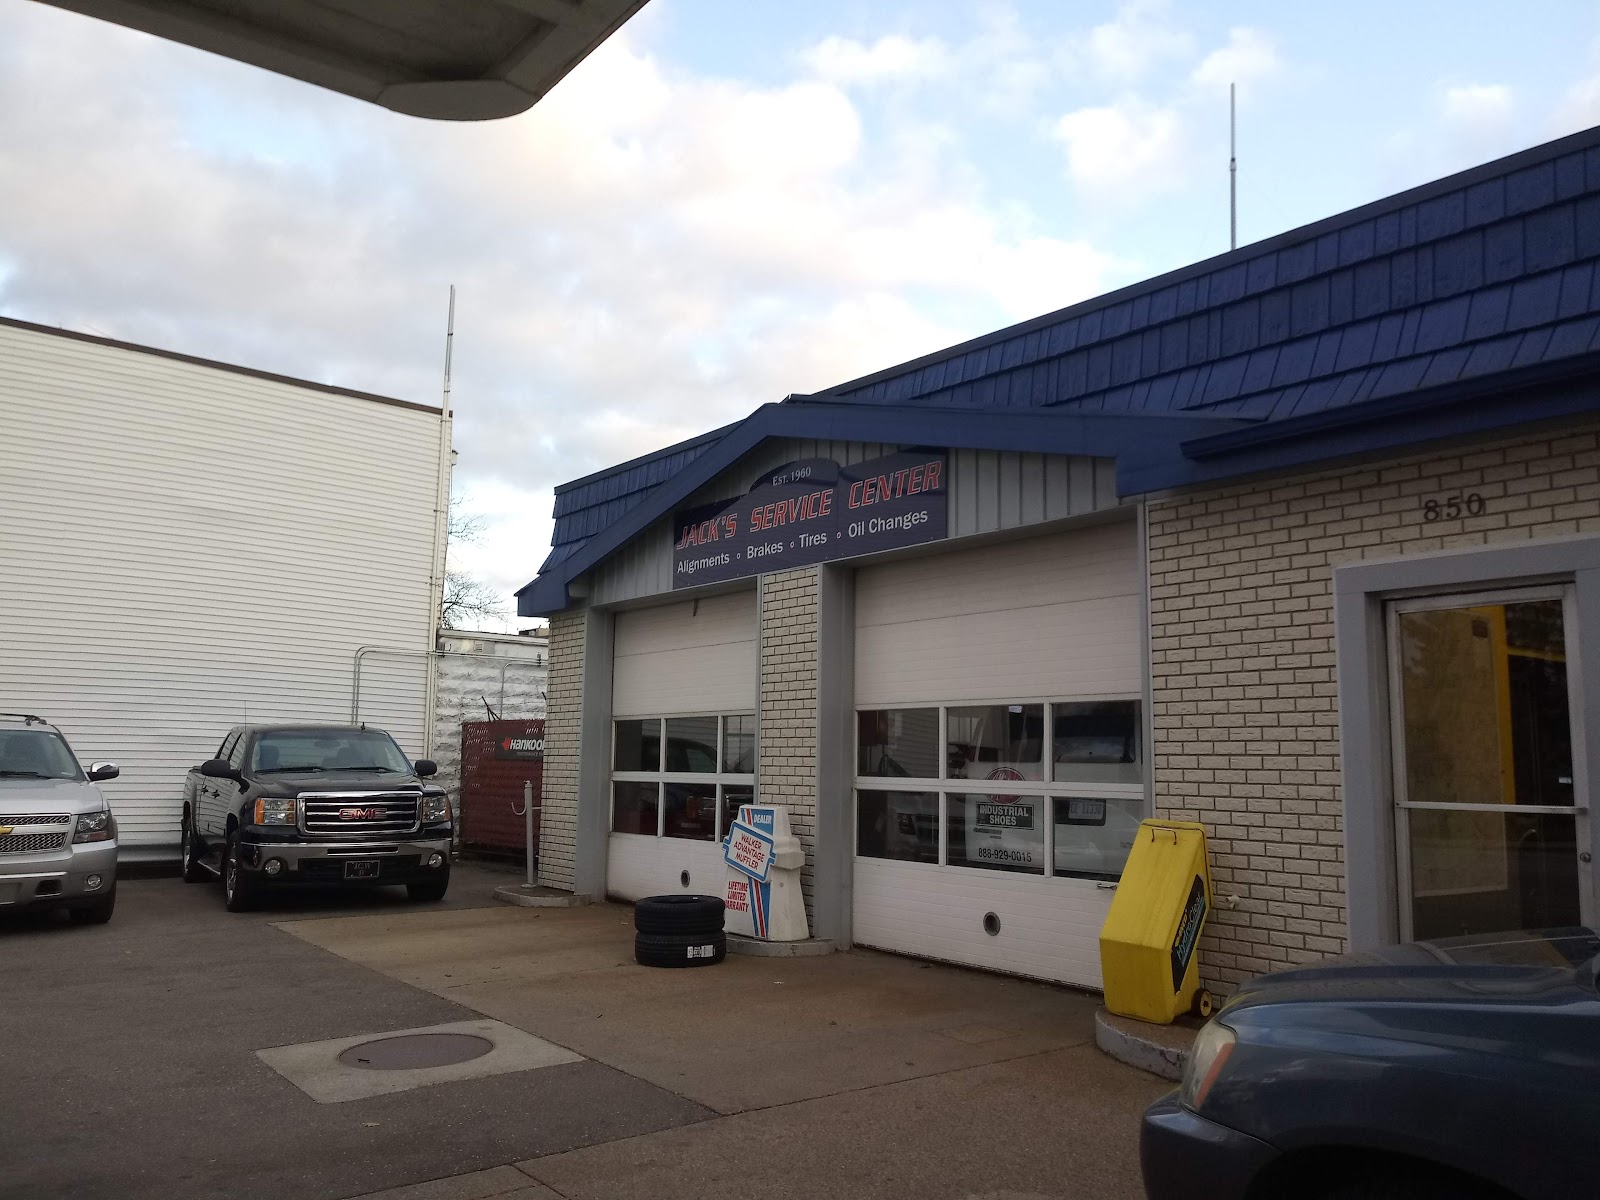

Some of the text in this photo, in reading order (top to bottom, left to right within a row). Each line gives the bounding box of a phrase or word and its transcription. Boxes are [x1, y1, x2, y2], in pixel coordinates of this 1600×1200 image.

[791, 466, 811, 482] 1960
[676, 460, 942, 550] JACK'S SERVICE CENTER
[1424, 493, 1484, 521] 850
[677, 510, 928, 574] Alignments Brakes Tires Oil Changes
[339, 808, 387, 820] GMC
[979, 805, 1028, 817] INDUSTRIAL
[753, 814, 772, 825] DEALER
[989, 815, 1017, 826] SHOES
[741, 833, 762, 850] WALKER
[733, 841, 765, 863] ADVANTAGE
[735, 853, 759, 871] MUFFLER
[728, 881, 749, 892] LIFETIME
[727, 890, 747, 901] LIMITED
